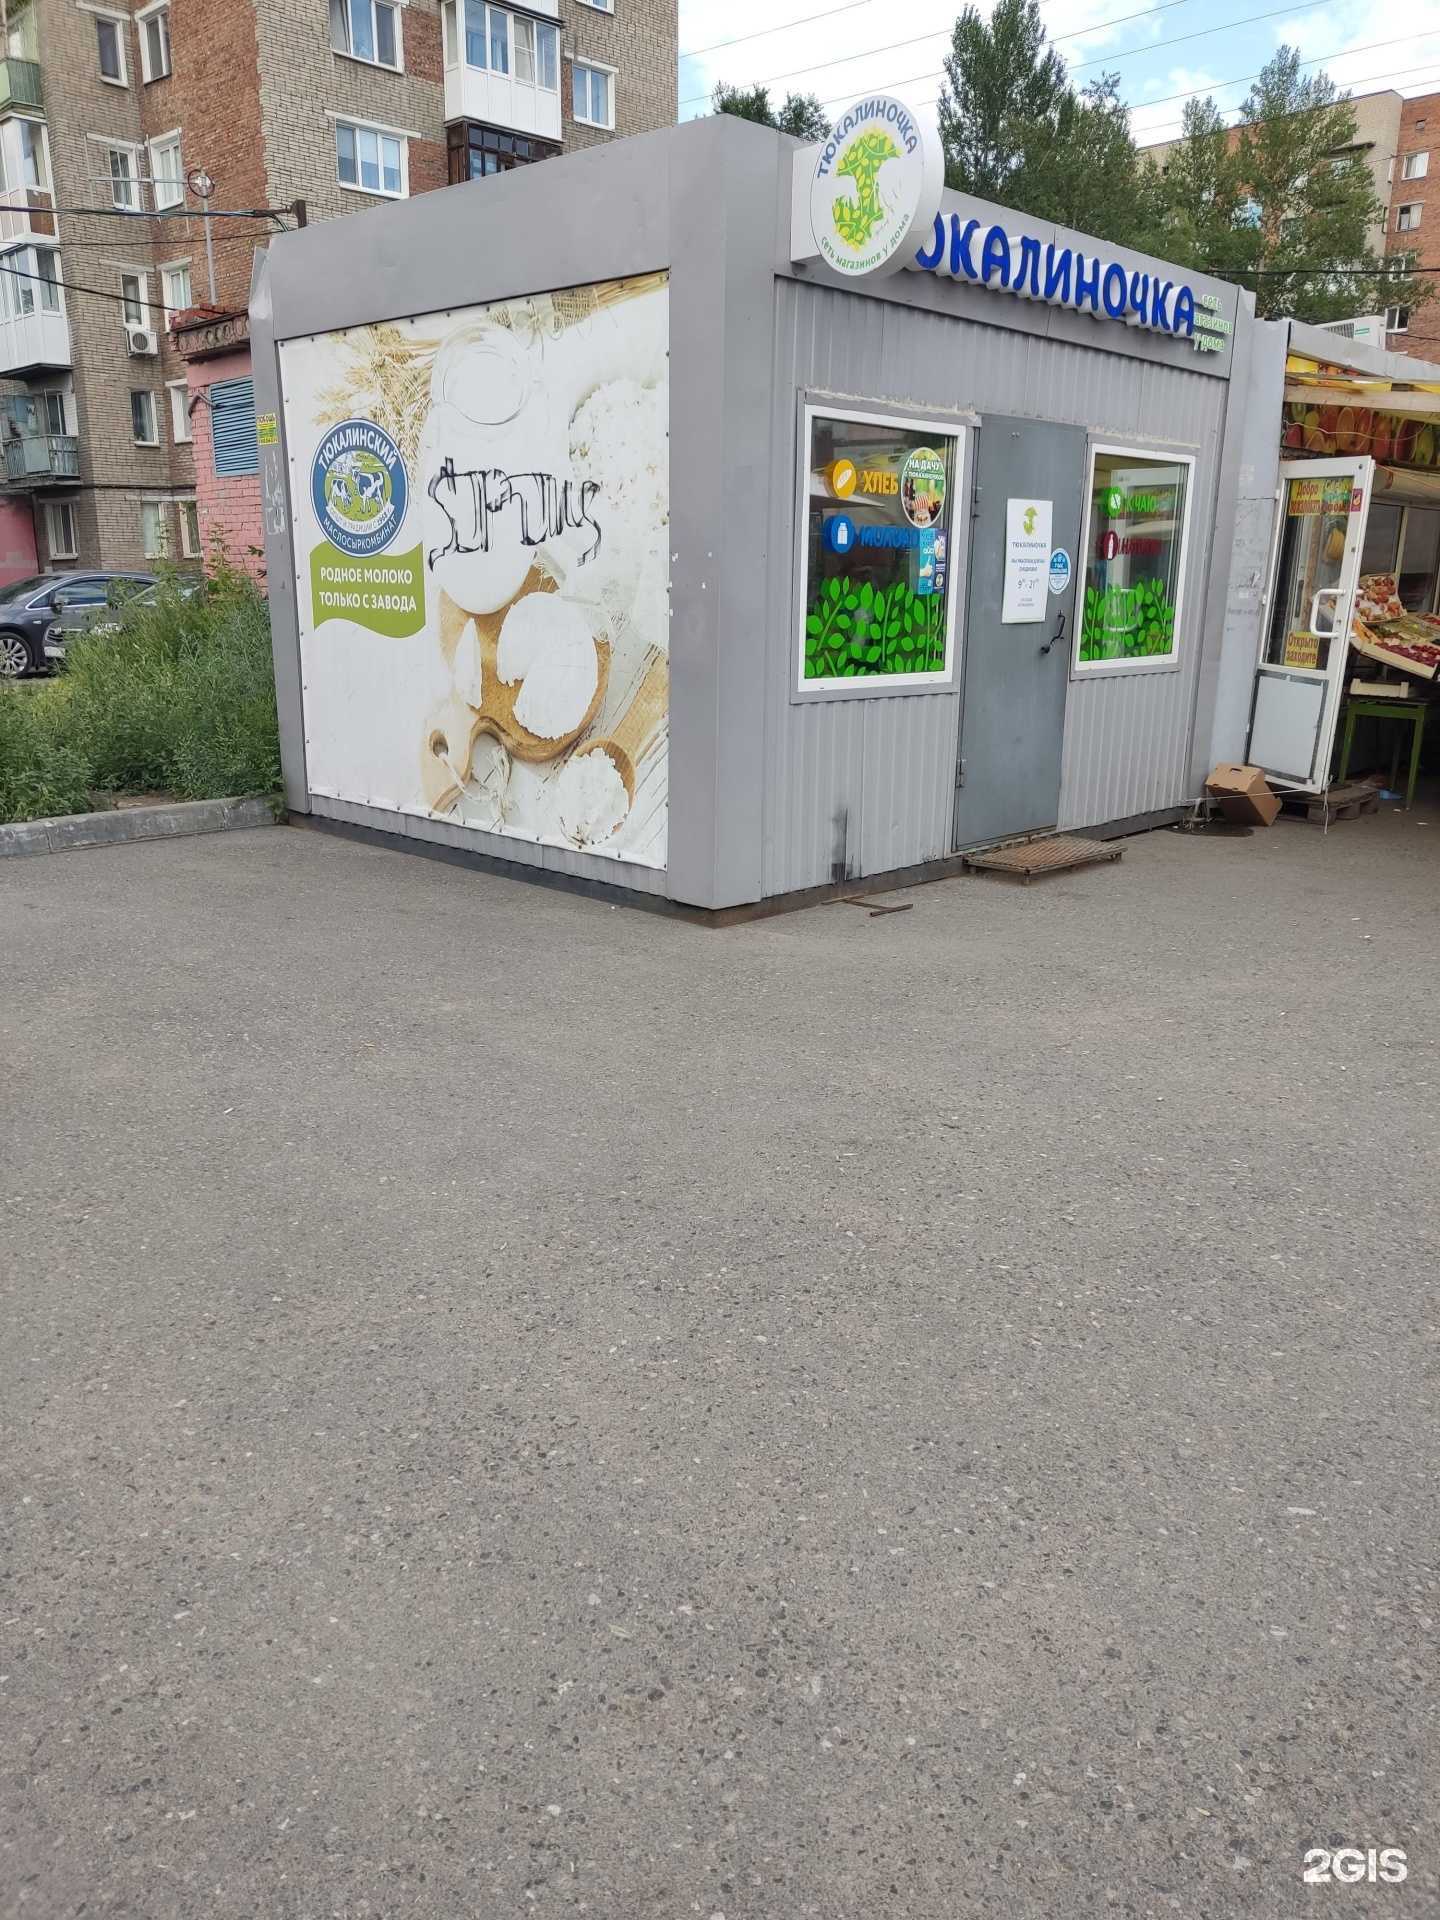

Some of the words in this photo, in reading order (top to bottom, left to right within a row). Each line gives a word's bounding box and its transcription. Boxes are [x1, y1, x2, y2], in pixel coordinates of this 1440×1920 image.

[817, 100, 917, 178] ТЮКАЛИНОЧКА
[836, 252, 881, 270] магазинов
[881, 245, 889, 258] у
[890, 214, 910, 248] дома
[318, 427, 398, 470] ТЮКАЛИНСКИЙ
[909, 459, 921, 469] НА
[920, 460, 940, 471] ДАЧУ
[863, 470, 899, 495] ХЛЕБ
[323, 513, 398, 550] МАСЛОСЫРКОМБИНАТ
[320, 567, 362, 584] РОДНОЕ
[364, 568, 412, 584] МОЛОКО
[319, 591, 360, 608] ТОЛЬКО
[362, 594, 370, 608] С
[371, 594, 417, 613] ЗАВОДА
